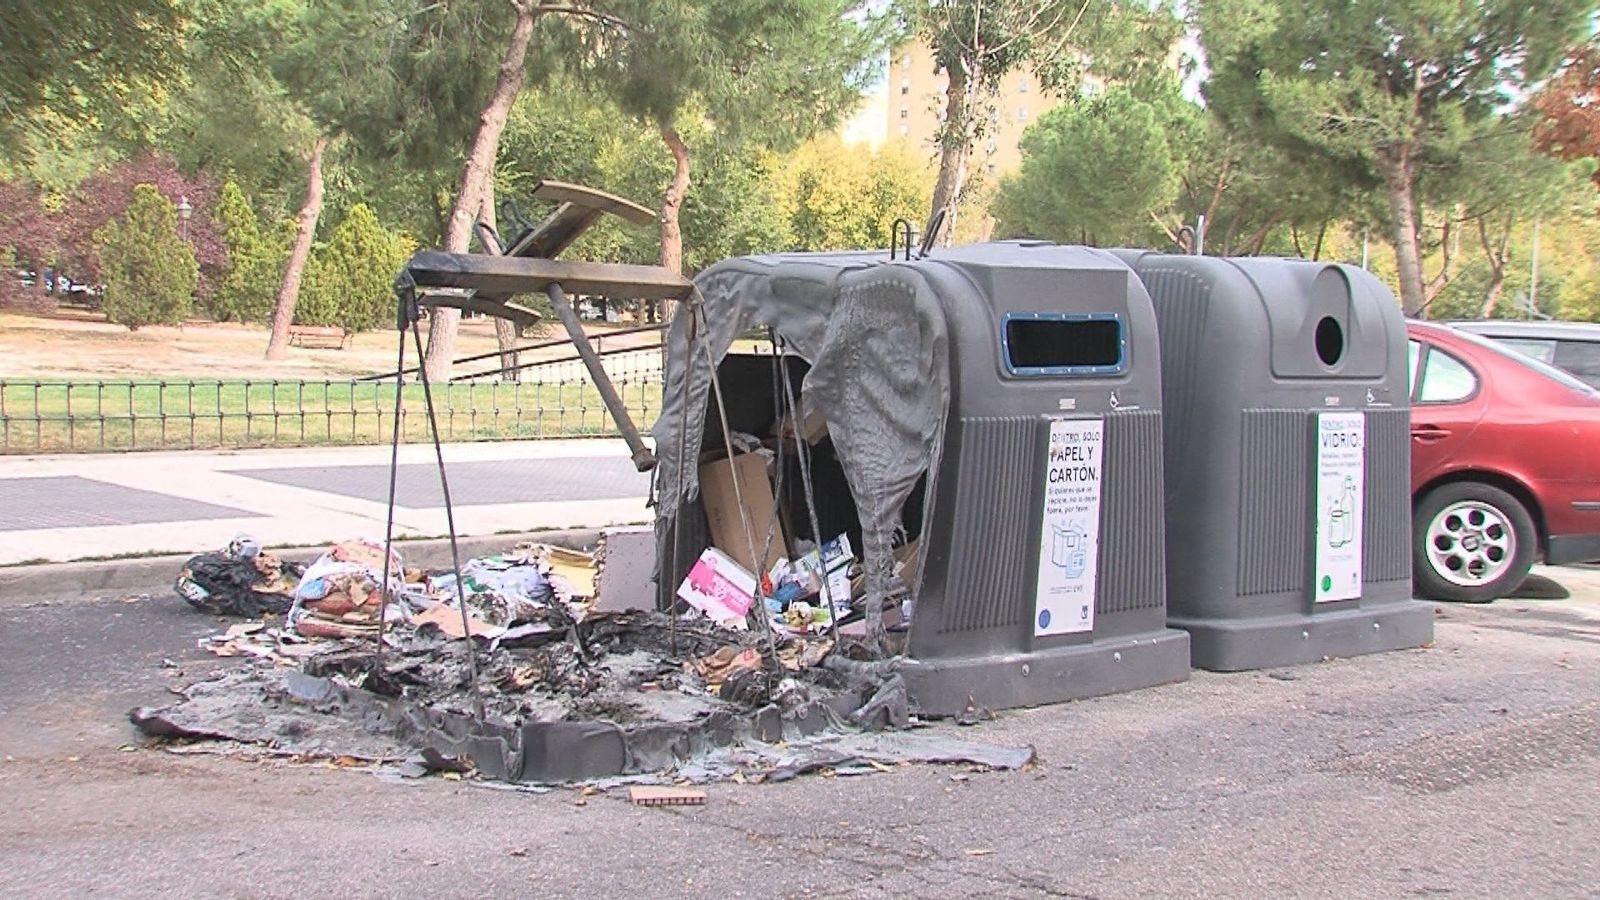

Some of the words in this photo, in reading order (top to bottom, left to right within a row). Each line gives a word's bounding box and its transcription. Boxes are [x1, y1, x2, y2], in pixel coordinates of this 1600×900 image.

[1083, 431, 1100, 441] SOLO
[1087, 446, 1094, 460] Y
[1049, 464, 1099, 483] CARTÓN.
